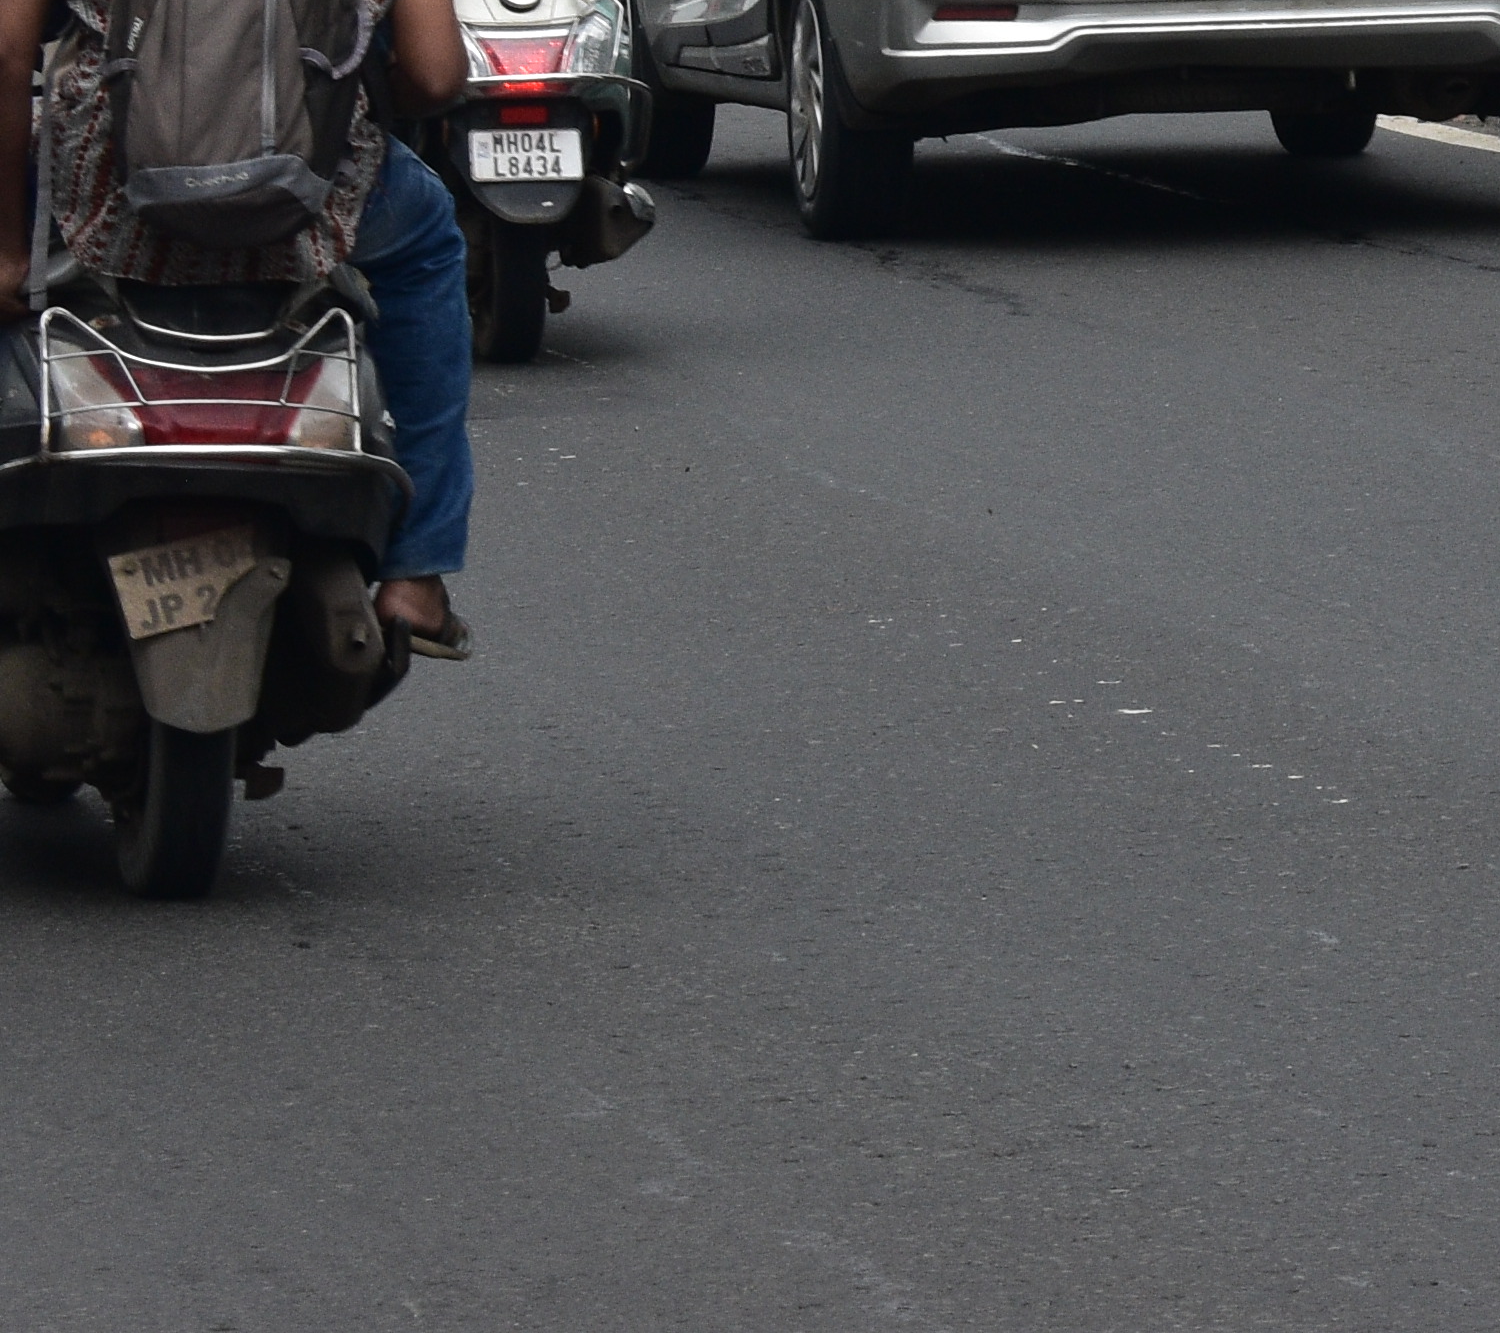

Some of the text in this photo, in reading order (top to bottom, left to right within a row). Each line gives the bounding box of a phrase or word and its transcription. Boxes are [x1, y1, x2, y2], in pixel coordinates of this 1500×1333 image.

[493, 132, 562, 154] MH04L
[493, 155, 562, 177] L8434
[140, 548, 203, 586] MH
[140, 593, 184, 630] JP
